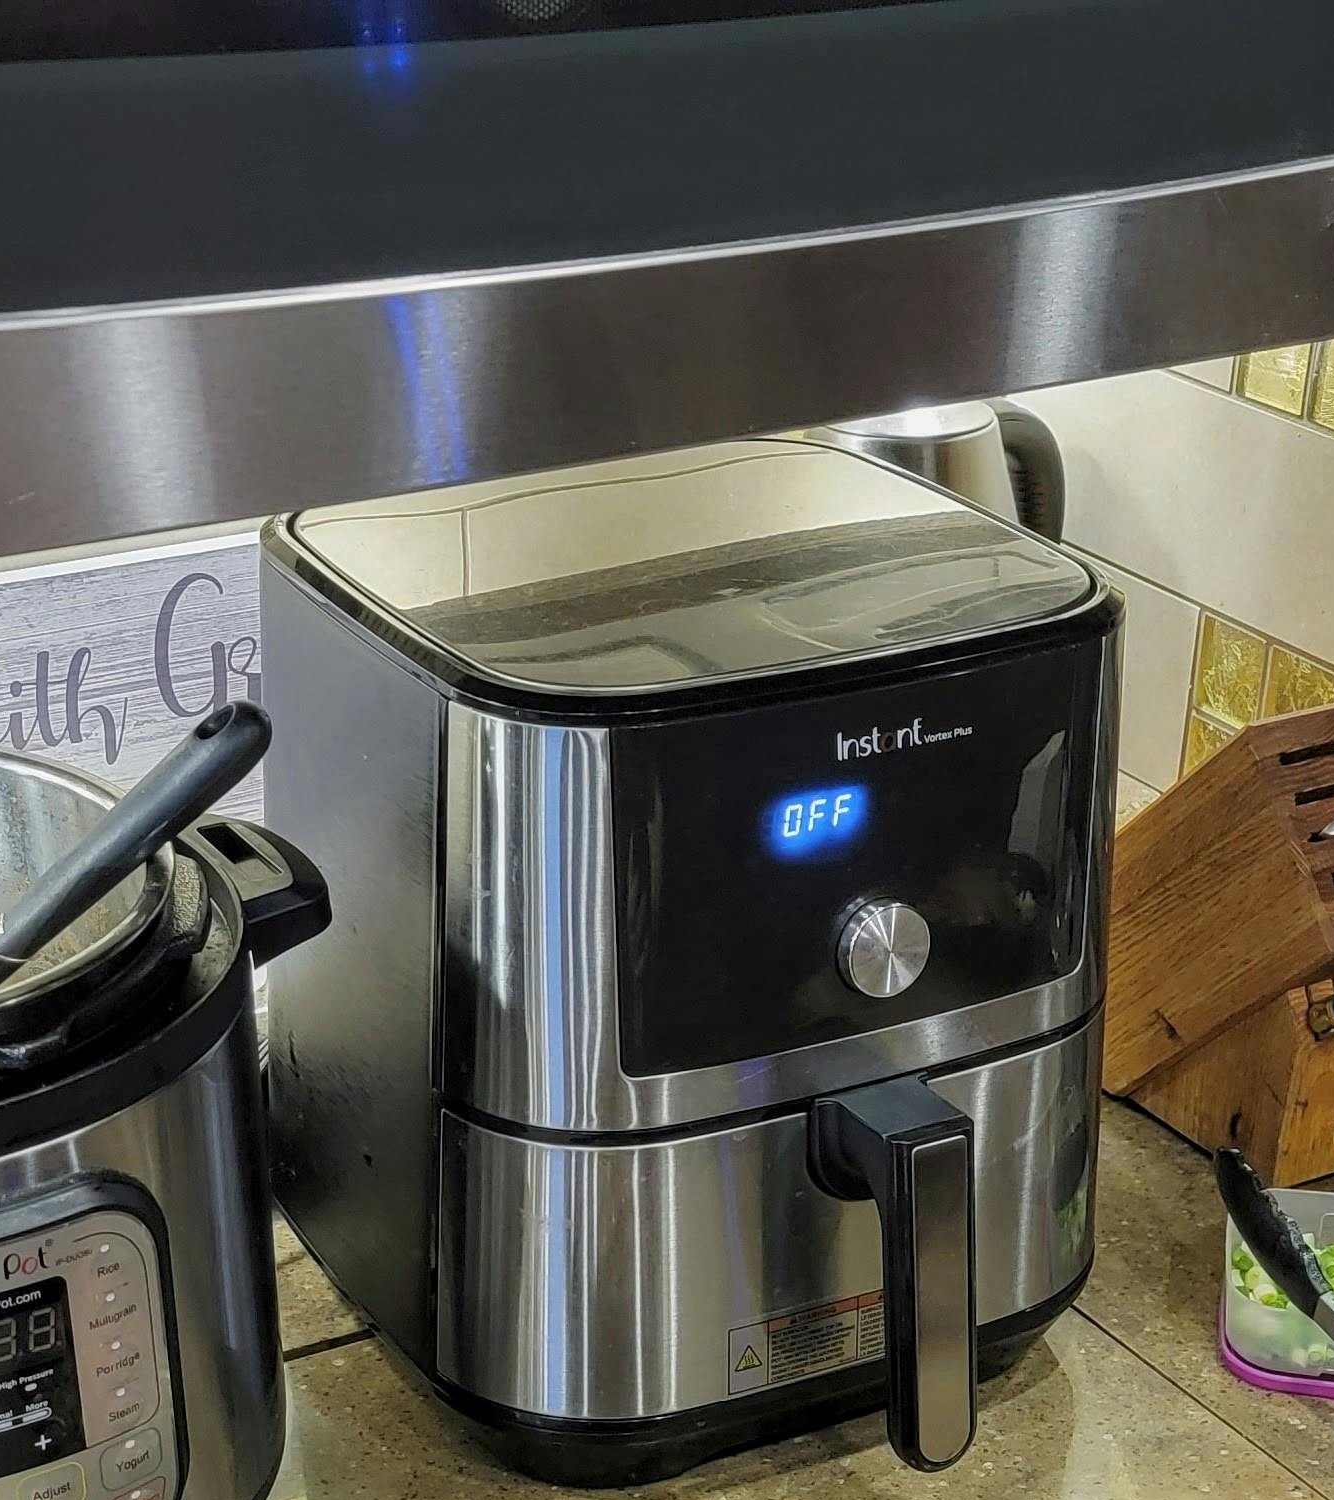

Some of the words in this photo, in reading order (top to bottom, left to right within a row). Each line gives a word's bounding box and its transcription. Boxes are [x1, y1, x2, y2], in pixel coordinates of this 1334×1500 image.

[836, 717, 923, 762] Instant
[923, 729, 953, 744] Vortex
[953, 726, 973, 738] Plus
[783, 793, 852, 837] OFF
[97, 1262, 120, 1278] Rice
[89, 1303, 137, 1330] Multigrain
[96, 1351, 140, 1377] Porridge
[19, 1368, 54, 1385] Pressure
[25, 1399, 49, 1412] More
[108, 1402, 140, 1423] Steam
[116, 1450, 150, 1473] Yogurt
